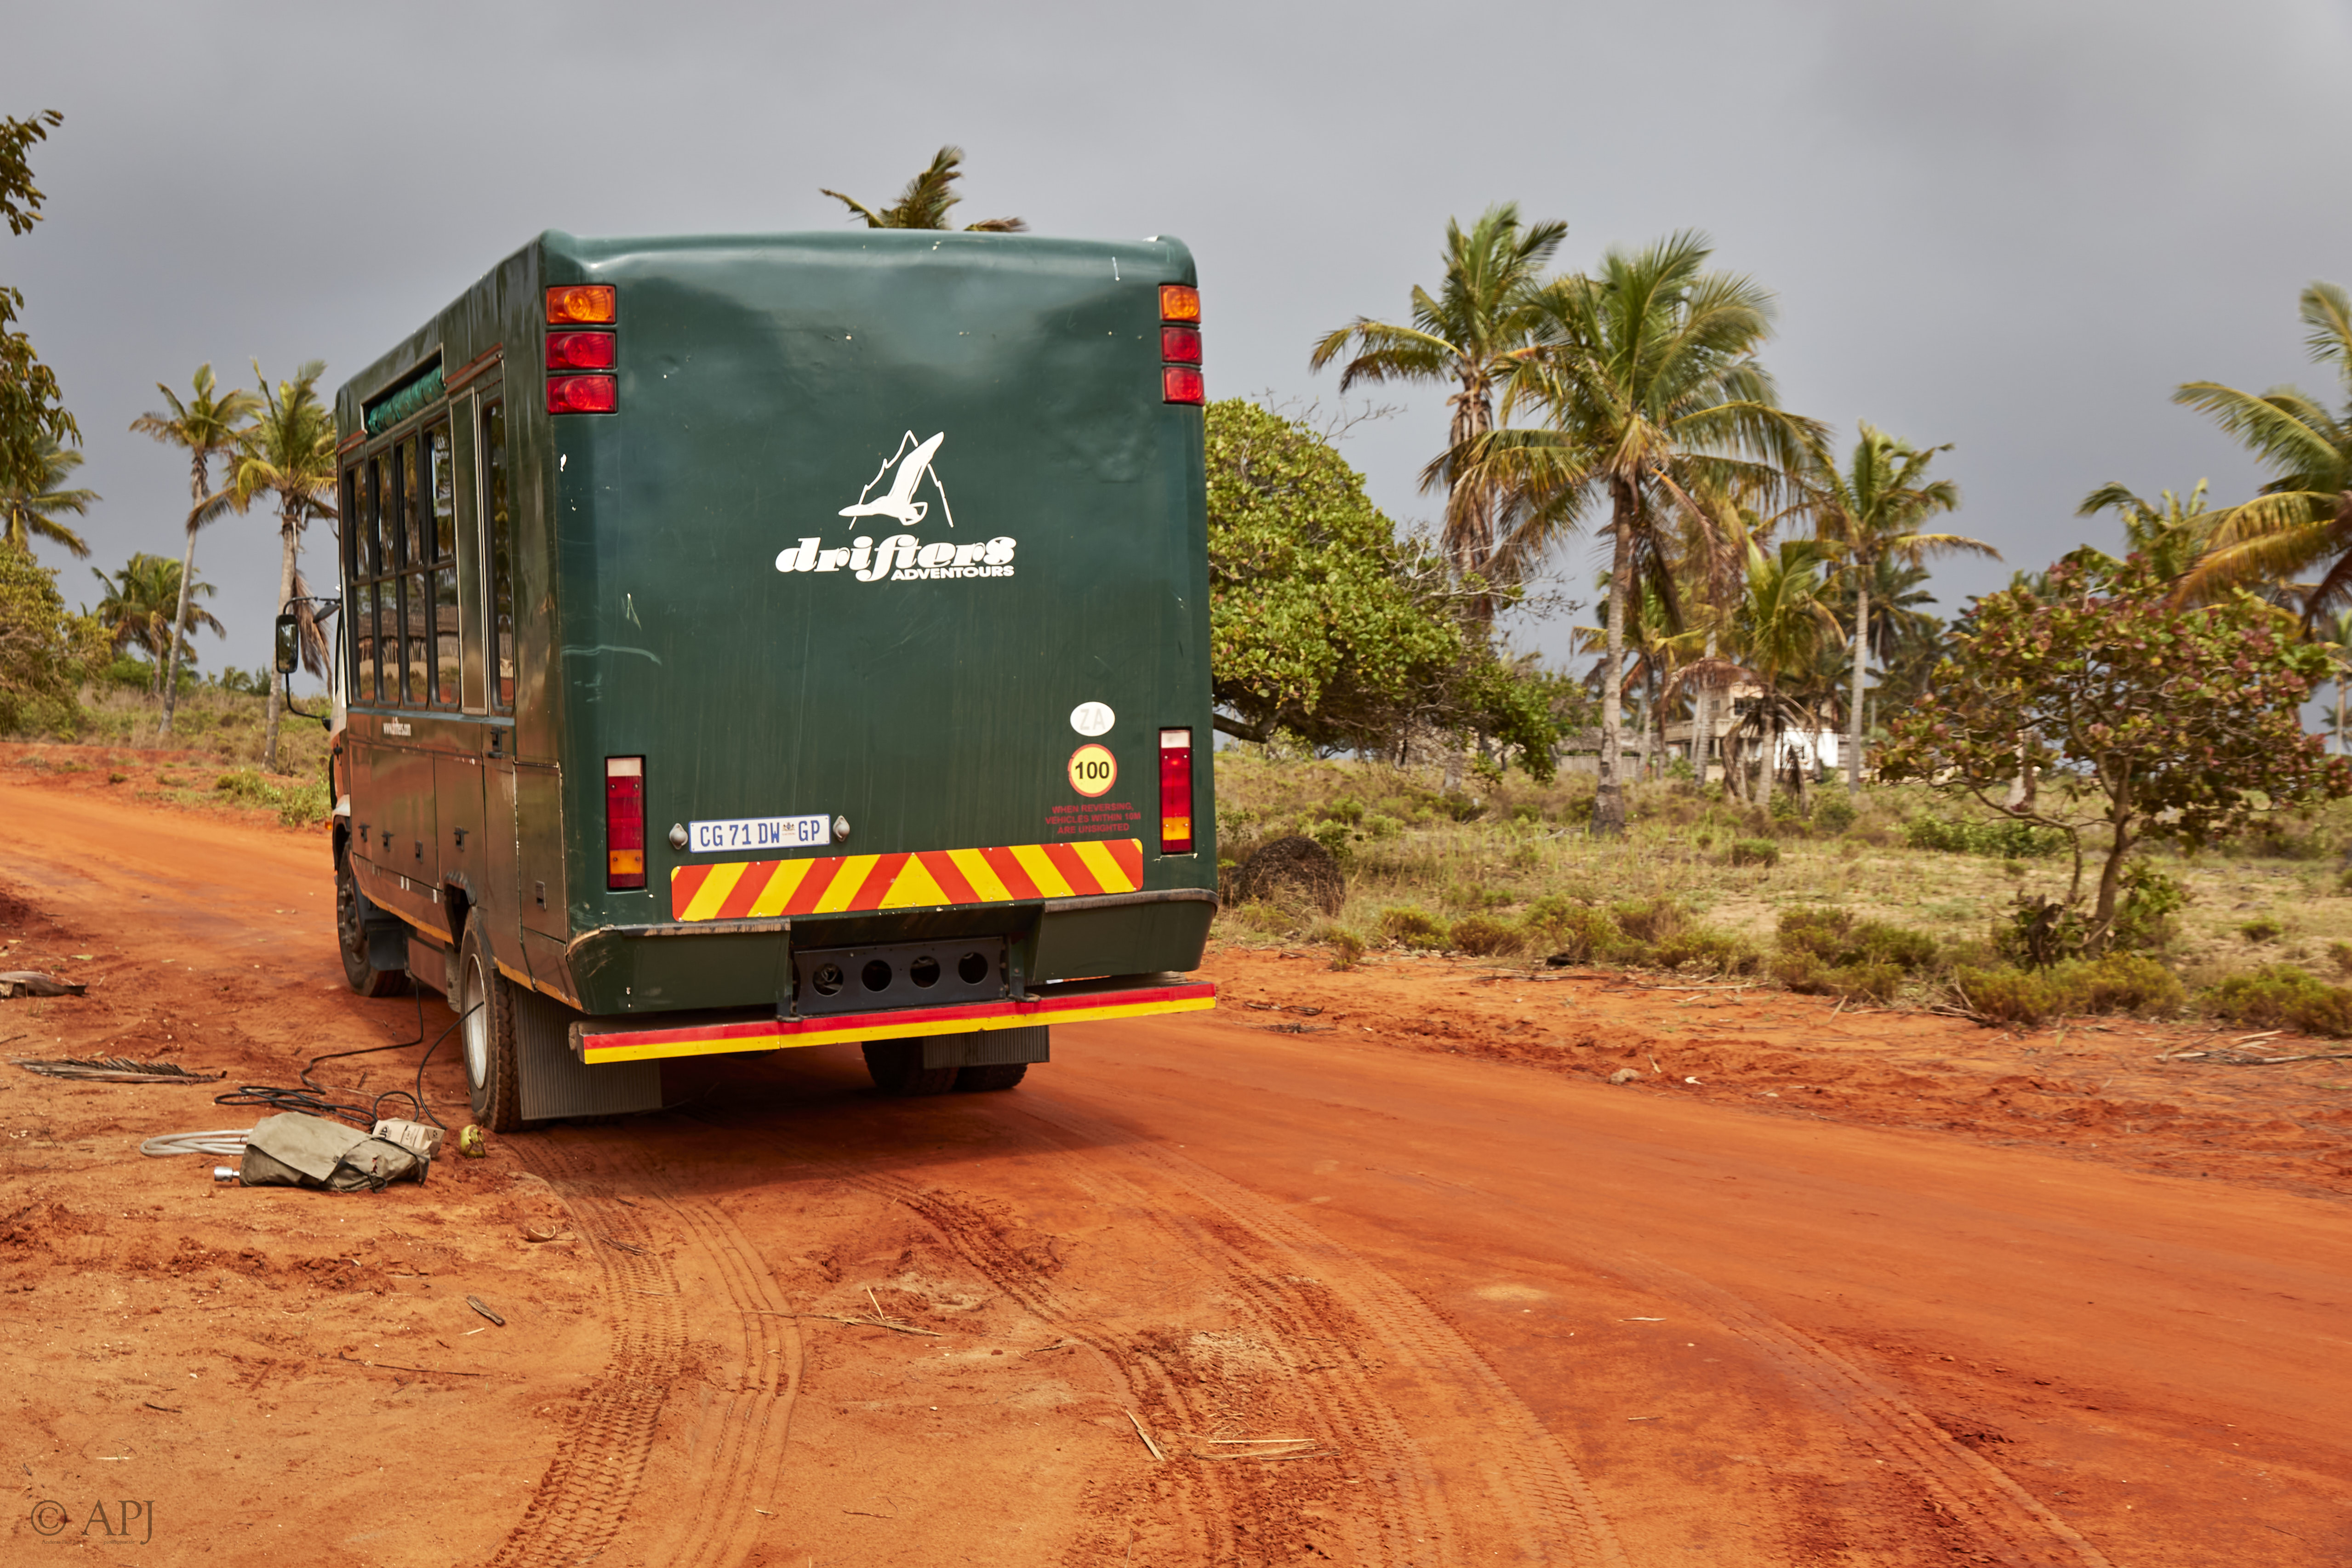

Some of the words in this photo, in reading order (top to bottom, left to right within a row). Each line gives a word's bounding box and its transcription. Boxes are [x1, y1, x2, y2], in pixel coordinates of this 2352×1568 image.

[776, 534, 1016, 582] drifters
[891, 565, 1015, 581] ADVENTOURS
[1080, 708, 1106, 730] ZA
[1075, 761, 1110, 779] 100
[1051, 805, 1079, 814] WHEN
[1081, 802, 1134, 812] REVERSING,
[1045, 815, 1090, 825] VEHICLES
[1091, 813, 1122, 822] WITHIN
[1125, 812, 1142, 820] 10M
[700, 826, 723, 847] CG
[729, 824, 752, 846] 71
[758, 822, 780, 844] DW
[799, 820, 820, 842] GP
[1057, 826, 1076, 834] ARE
[1078, 822, 1130, 833] UNSIGHTED
